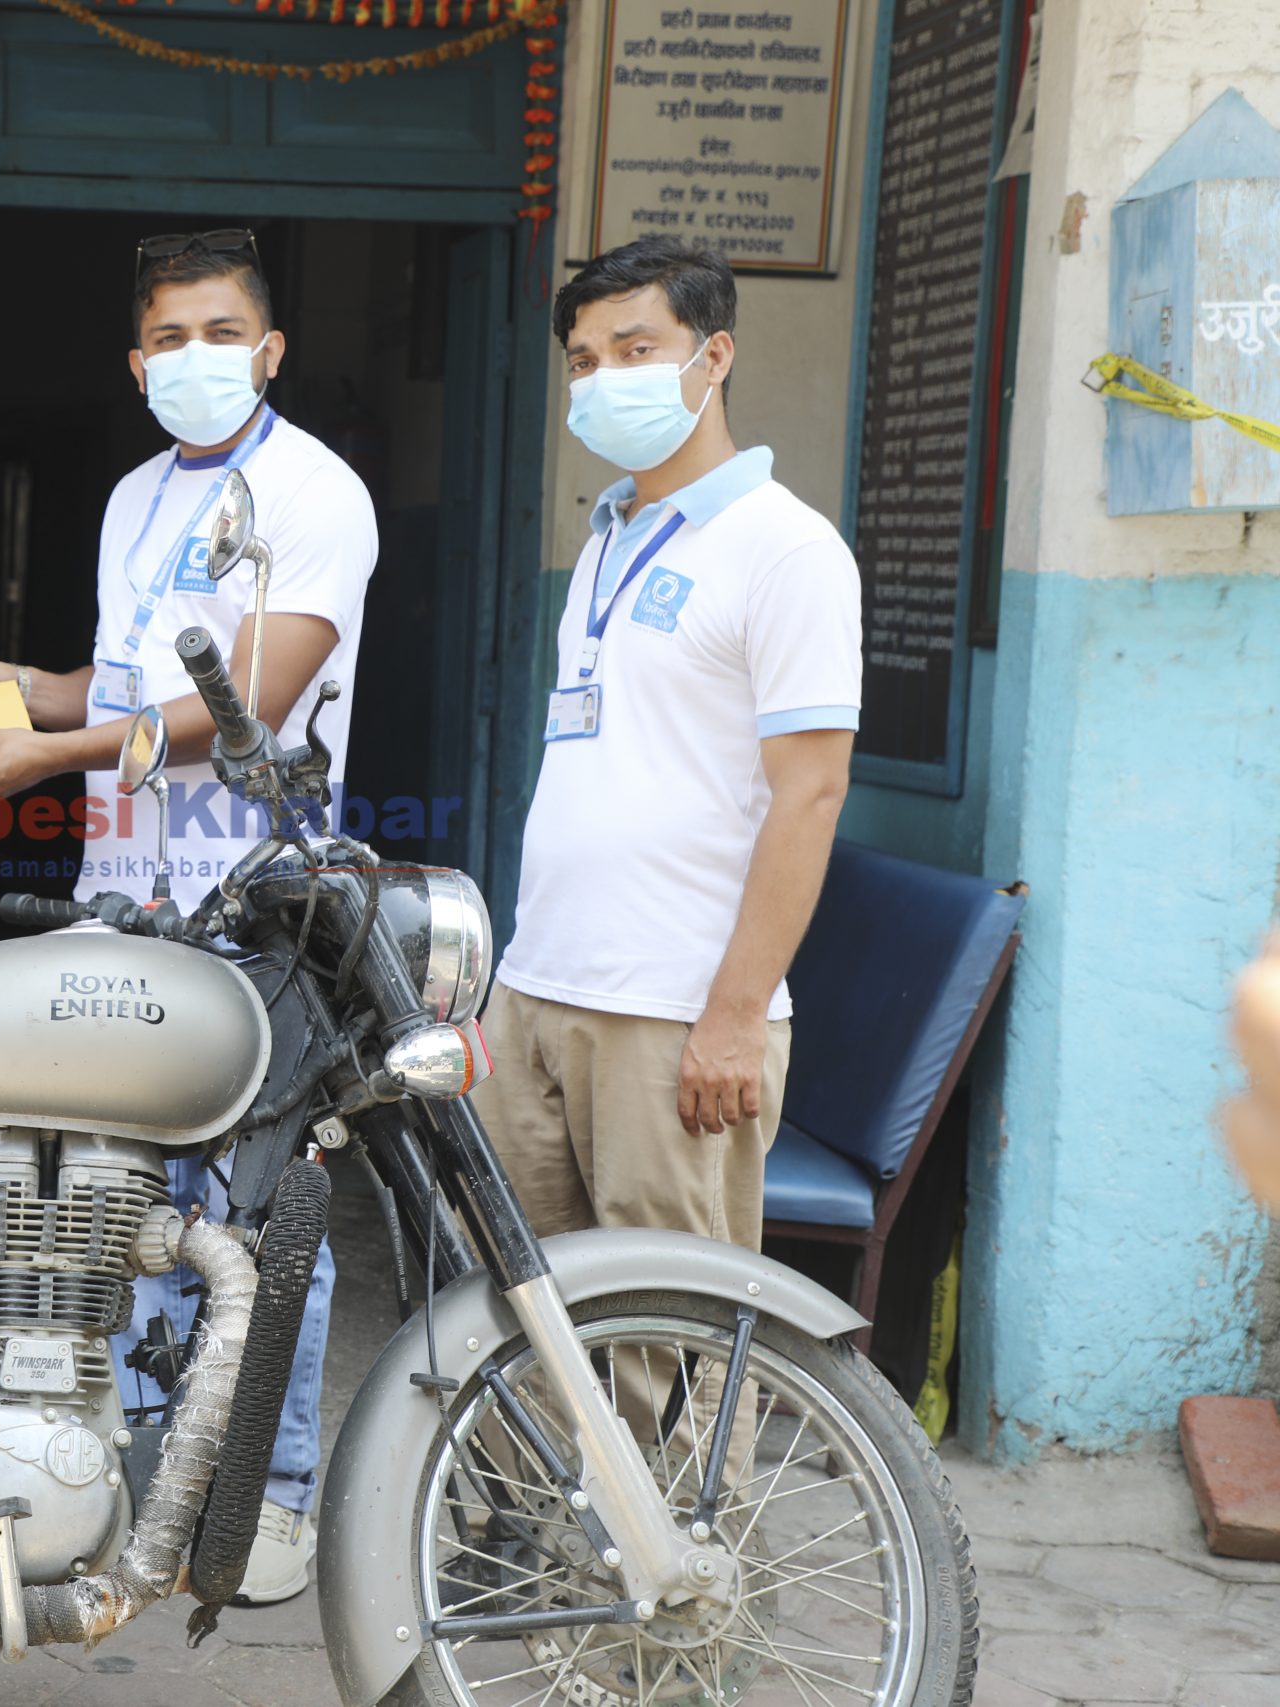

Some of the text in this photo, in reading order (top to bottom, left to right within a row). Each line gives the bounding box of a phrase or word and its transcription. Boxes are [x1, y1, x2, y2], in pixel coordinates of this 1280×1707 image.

[60, 972, 153, 996] ROYAL
[50, 999, 166, 1025] ENFIELD
[11, 1355, 67, 1370] TWINSPARK
[30, 1371, 46, 1379] 350
